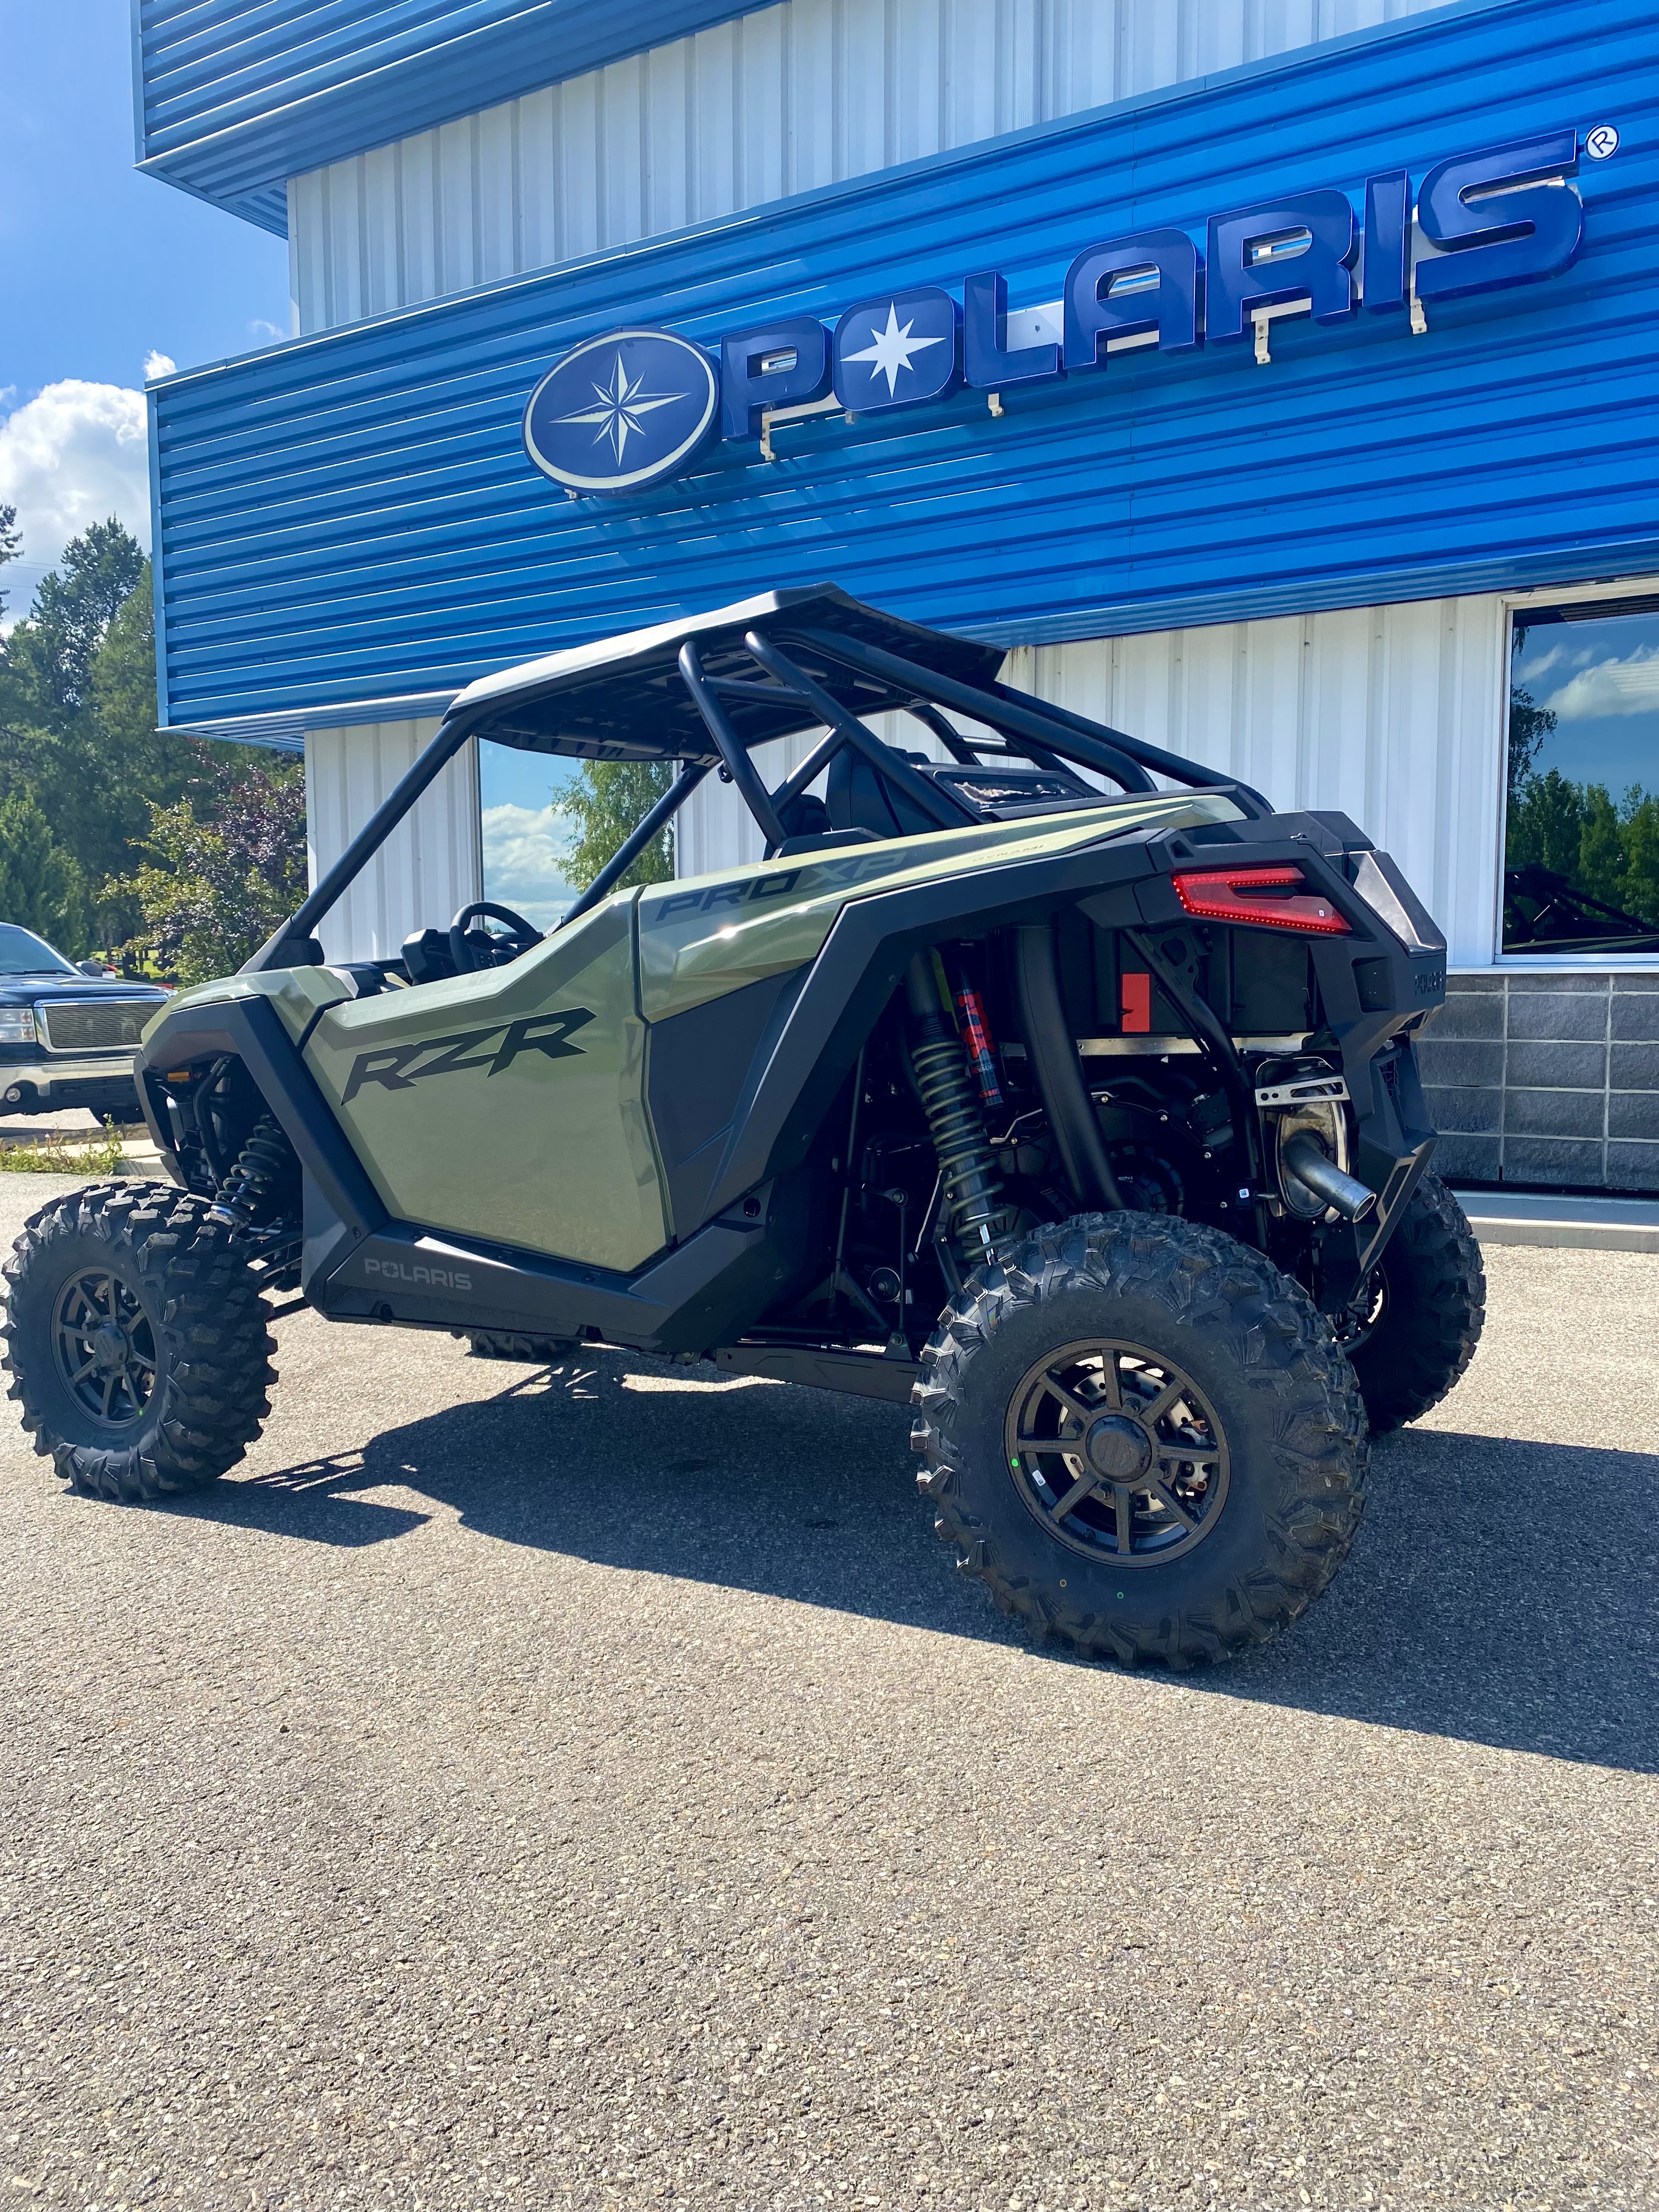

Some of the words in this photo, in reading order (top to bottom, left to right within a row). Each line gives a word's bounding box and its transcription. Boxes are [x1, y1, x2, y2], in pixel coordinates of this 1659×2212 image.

[721, 128, 1583, 440] POLARIS
[655, 870, 803, 922] PRO
[802, 852, 907, 889] XP
[341, 1007, 597, 1106] RZR
[364, 1258, 472, 1290] POLARIS
